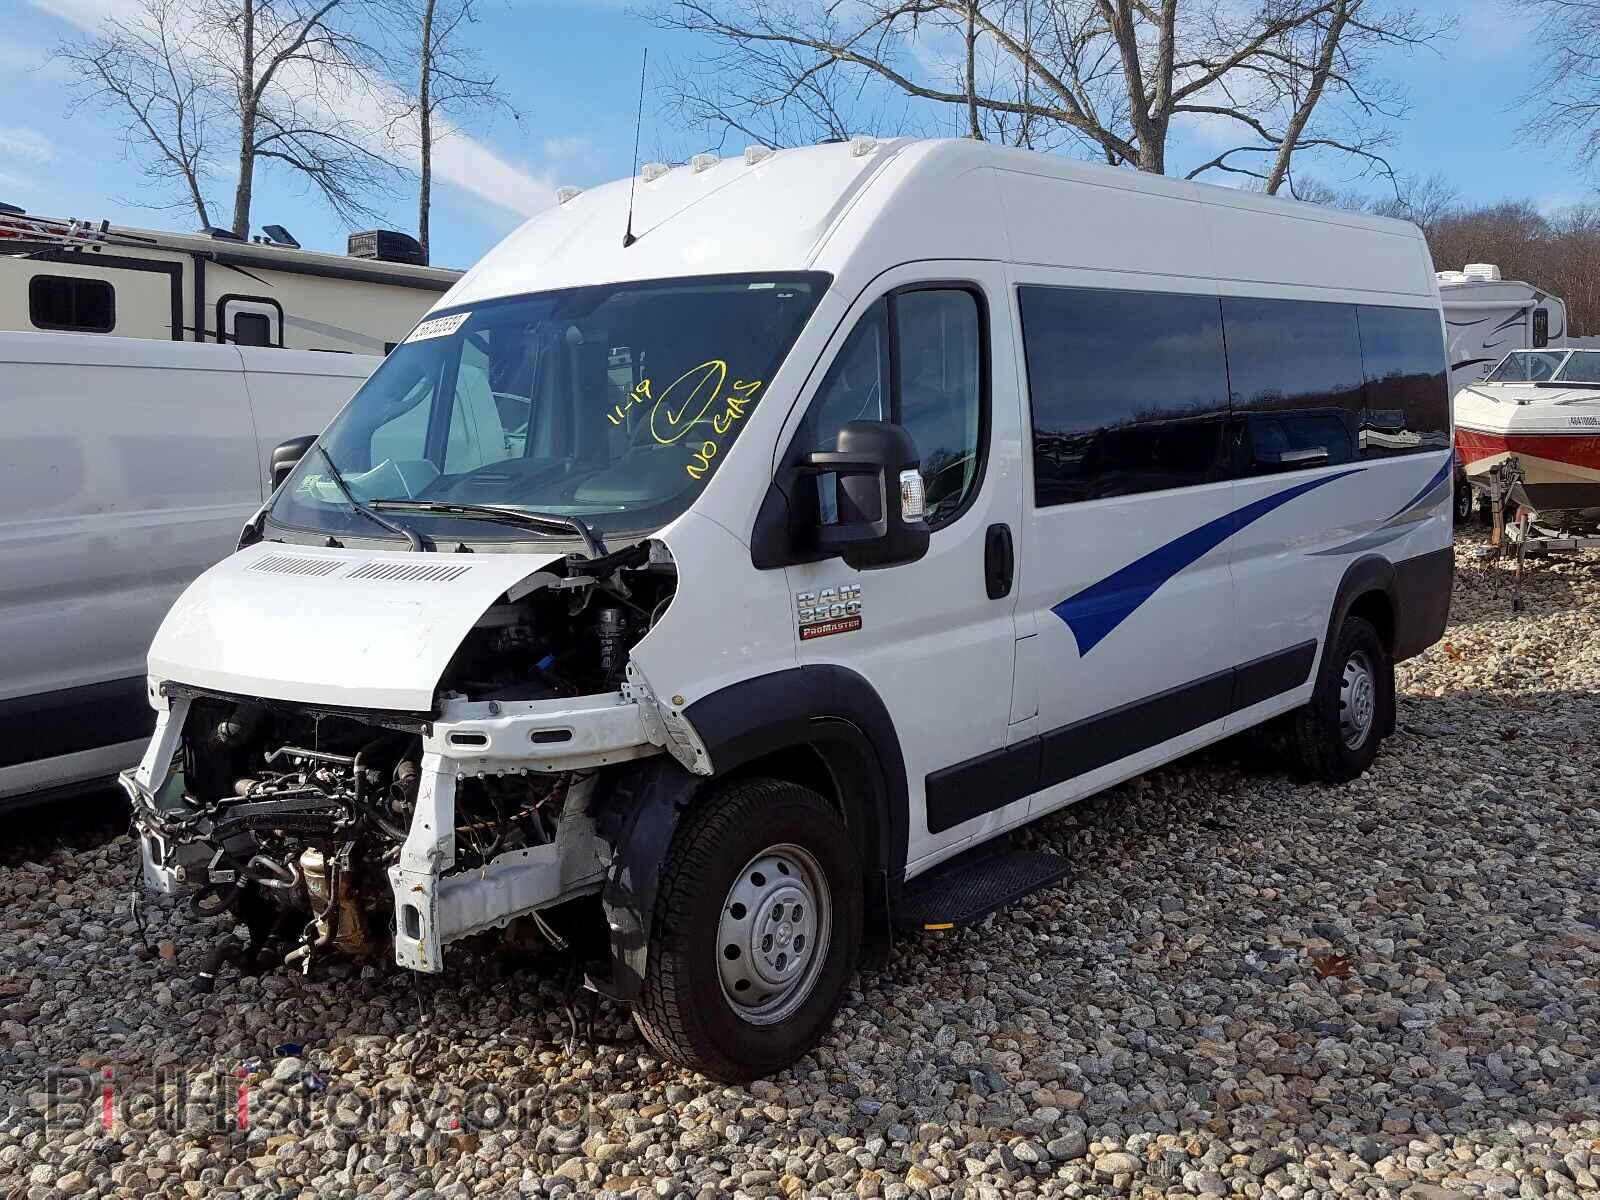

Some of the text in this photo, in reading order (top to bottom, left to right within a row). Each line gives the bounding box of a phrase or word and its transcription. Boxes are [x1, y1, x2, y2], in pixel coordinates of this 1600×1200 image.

[607, 379, 652, 424] 11-19
[686, 380, 762, 479] NO GAS
[797, 584, 861, 608] RAM
[799, 600, 861, 624] 3500
